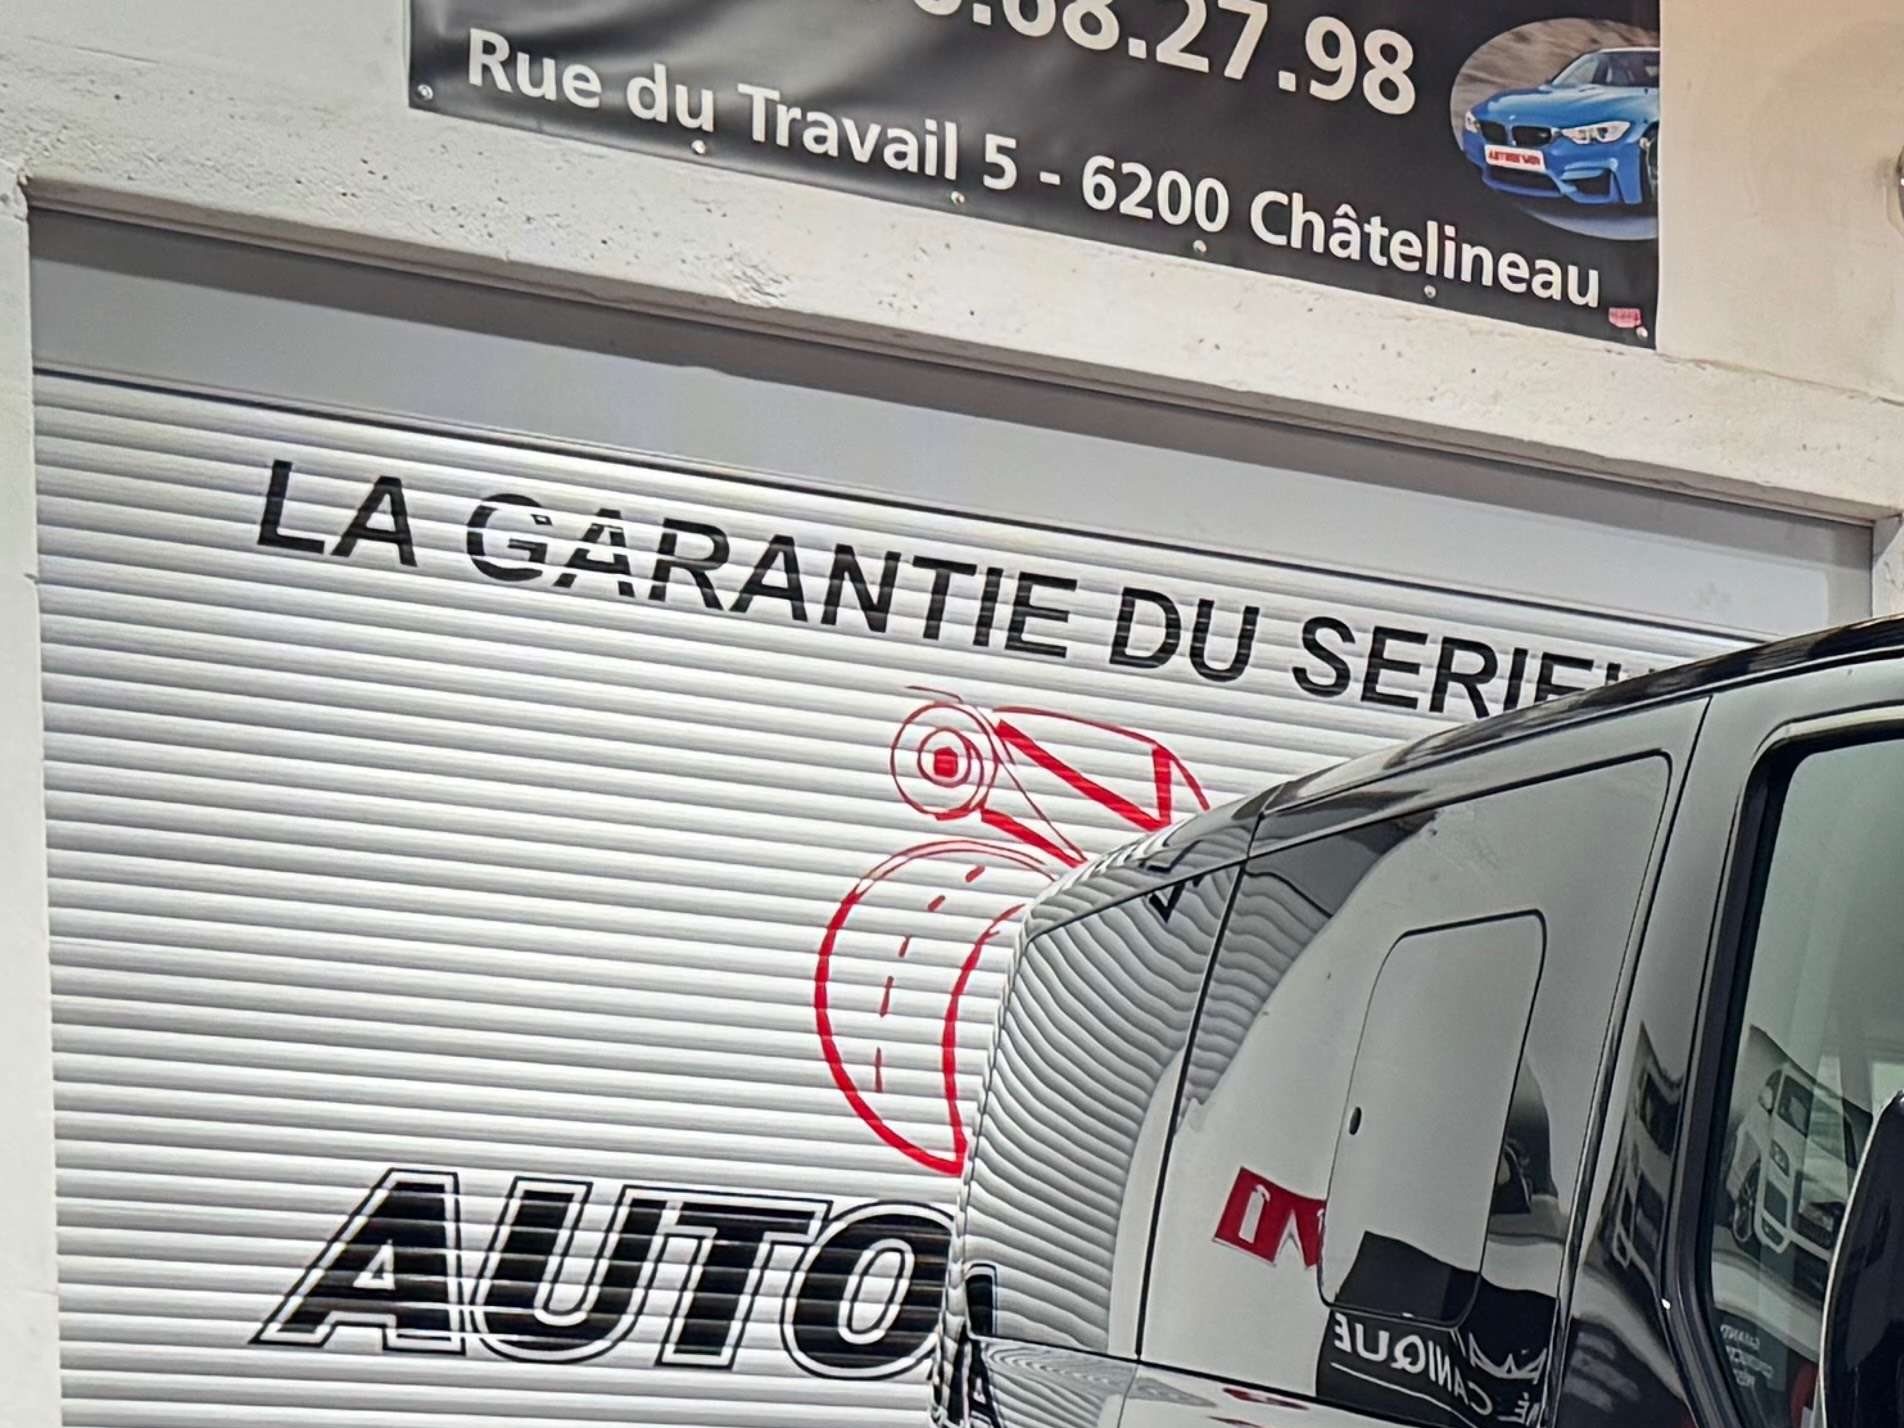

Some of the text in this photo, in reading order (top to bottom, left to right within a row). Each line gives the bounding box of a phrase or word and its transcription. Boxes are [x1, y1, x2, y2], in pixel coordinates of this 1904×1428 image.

[466, 28, 602, 109] Rue
[625, 62, 716, 136] du
[738, 85, 960, 183] Travail
[982, 132, 1020, 191] 5
[1081, 155, 1230, 234] 6200
[1250, 192, 1600, 309] Châtelineau
[257, 460, 1656, 718] LA GARANTIE DU SERIE
